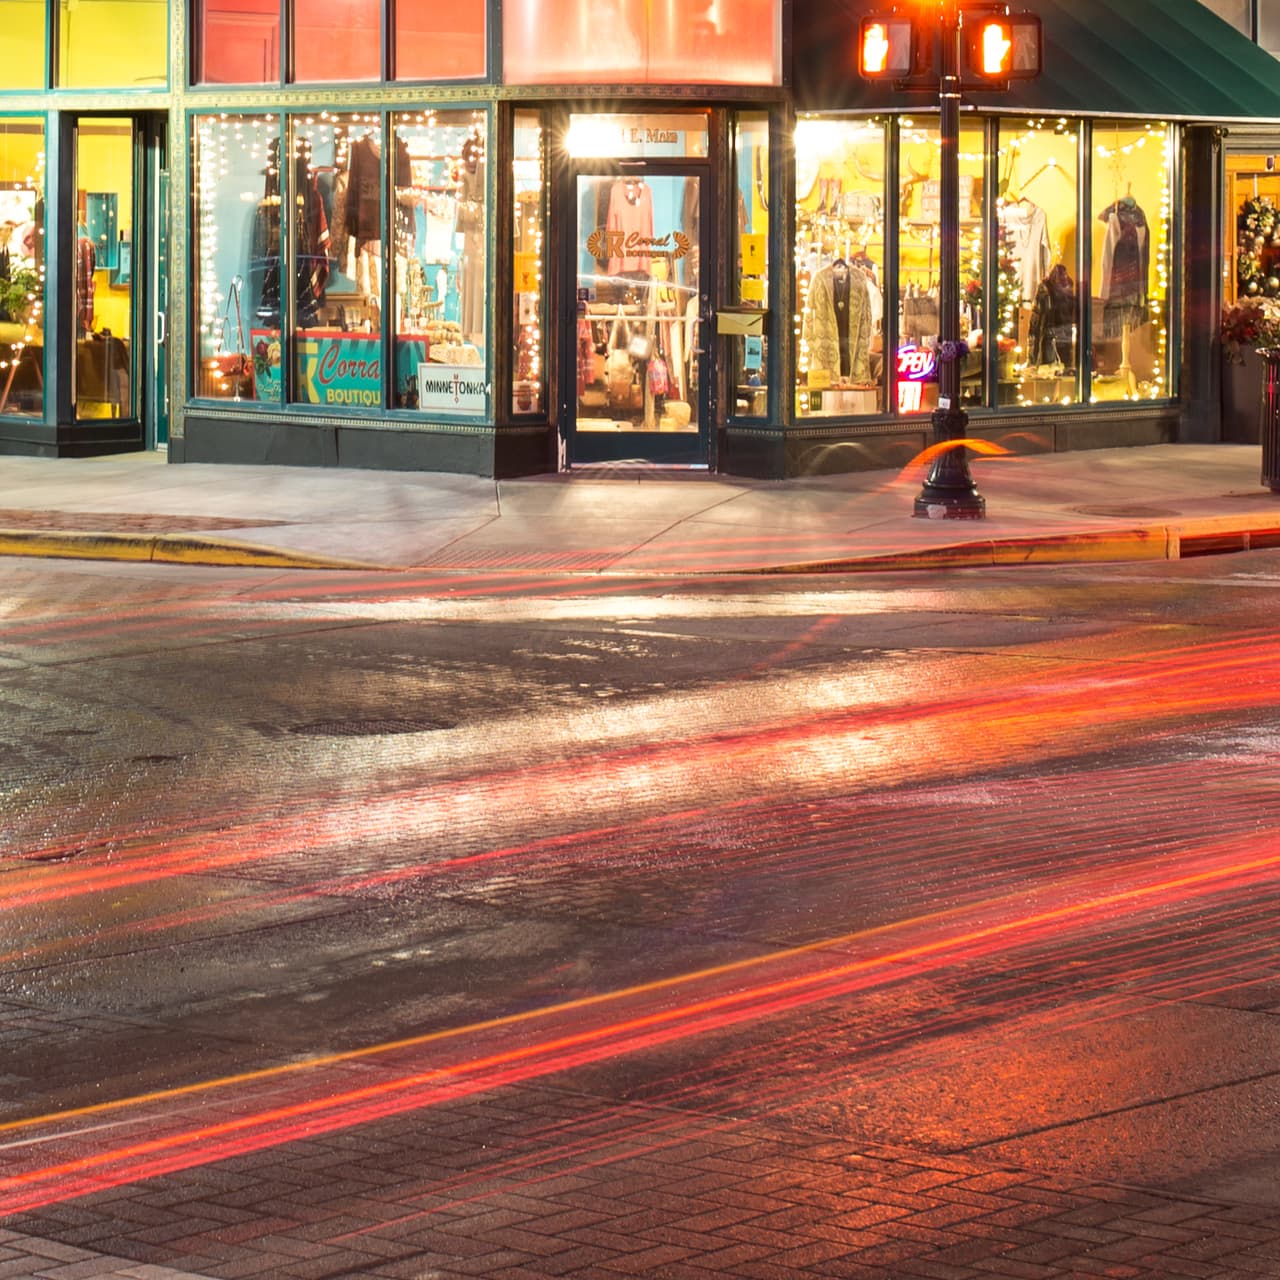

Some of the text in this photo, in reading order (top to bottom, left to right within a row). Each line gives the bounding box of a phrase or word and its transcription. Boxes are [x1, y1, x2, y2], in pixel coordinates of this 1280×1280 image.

[318, 344, 381, 385] Corra
[326, 388, 381, 407] BOUTIQU
[425, 376, 488, 401] MINNETONKA
